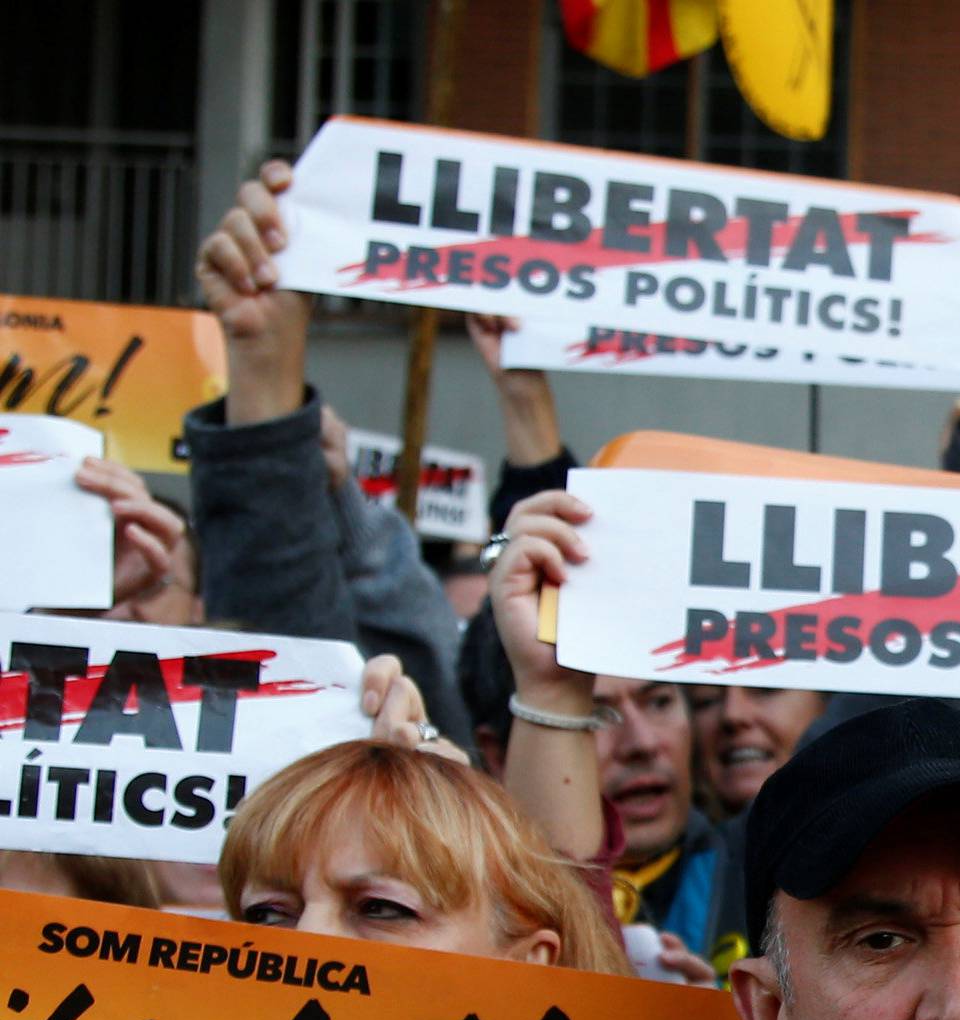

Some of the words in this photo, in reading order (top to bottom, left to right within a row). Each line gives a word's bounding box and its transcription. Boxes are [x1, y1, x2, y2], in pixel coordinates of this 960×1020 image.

[371, 151, 910, 281] LLIBERTAT
[363, 240, 597, 300] PRESOS
[623, 271, 903, 337] POLÍTICS!
[0, 641, 261, 754] TAT
[0, 748, 248, 829] ÍTICS!
[37, 921, 142, 965] SOM
[148, 941, 371, 997] REPÚBLICA
